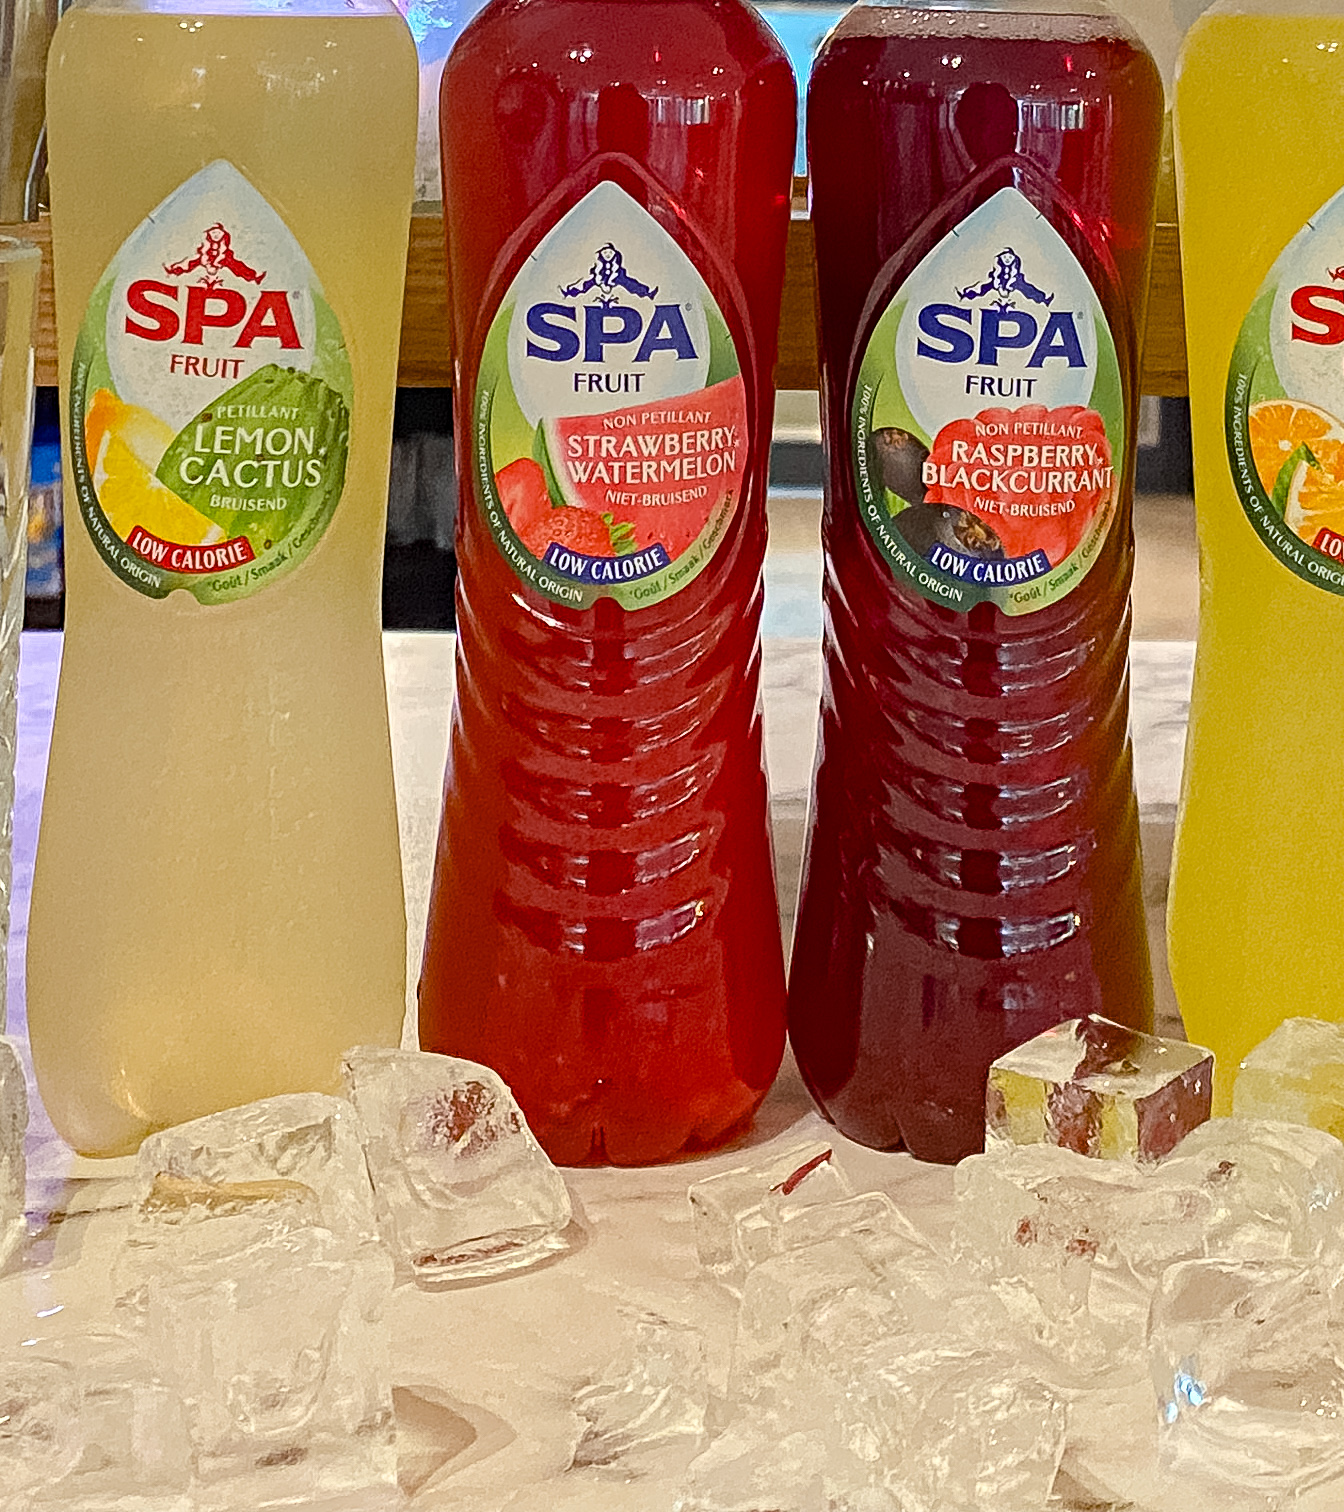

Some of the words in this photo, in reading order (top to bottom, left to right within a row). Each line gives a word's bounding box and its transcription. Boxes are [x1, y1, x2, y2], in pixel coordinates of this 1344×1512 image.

[125, 279, 304, 349] SPA
[526, 302, 699, 363] SPA
[917, 303, 1087, 368] SPA
[170, 354, 245, 379] FRUIT
[574, 372, 646, 392] FRUIT
[965, 374, 1037, 398] FRUIT
[217, 405, 299, 420] PETILLANT
[603, 415, 636, 431] NON
[641, 411, 711, 425] PETILLANT
[975, 423, 1009, 437] NON
[1014, 422, 1084, 439] PETILLANT
[179, 456, 322, 488] CACTUS
[567, 450, 736, 485] WATERMELON
[922, 461, 1114, 494] BLACKCURRANT
[209, 494, 287, 511] BRUISEND
[606, 485, 707, 507] NIET-BRUISEND
[1232, 406, 1254, 494] INGREDIENTS
[1249, 495, 1265, 513] OF
[1260, 515, 1304, 566] NATURAL
[478, 423, 495, 509] INGREDIENTS
[489, 510, 503, 529] OF
[497, 530, 537, 582] NATURAL
[538, 576, 584, 603] ORIGIN
[857, 416, 873, 503] INGREDIENTS
[867, 504, 882, 524] OF
[876, 524, 917, 577] NATURAL
[918, 572, 964, 602] ORIGIN
[88, 506, 119, 560] NATURAL
[120, 557, 161, 588] ORIGIN
[132, 531, 169, 563] LOW
[171, 541, 247, 569] CALORIE
[549, 548, 588, 577] LOW
[591, 548, 663, 580] CALORIE
[931, 547, 970, 577] LOW
[973, 554, 1044, 583] CALORIE
